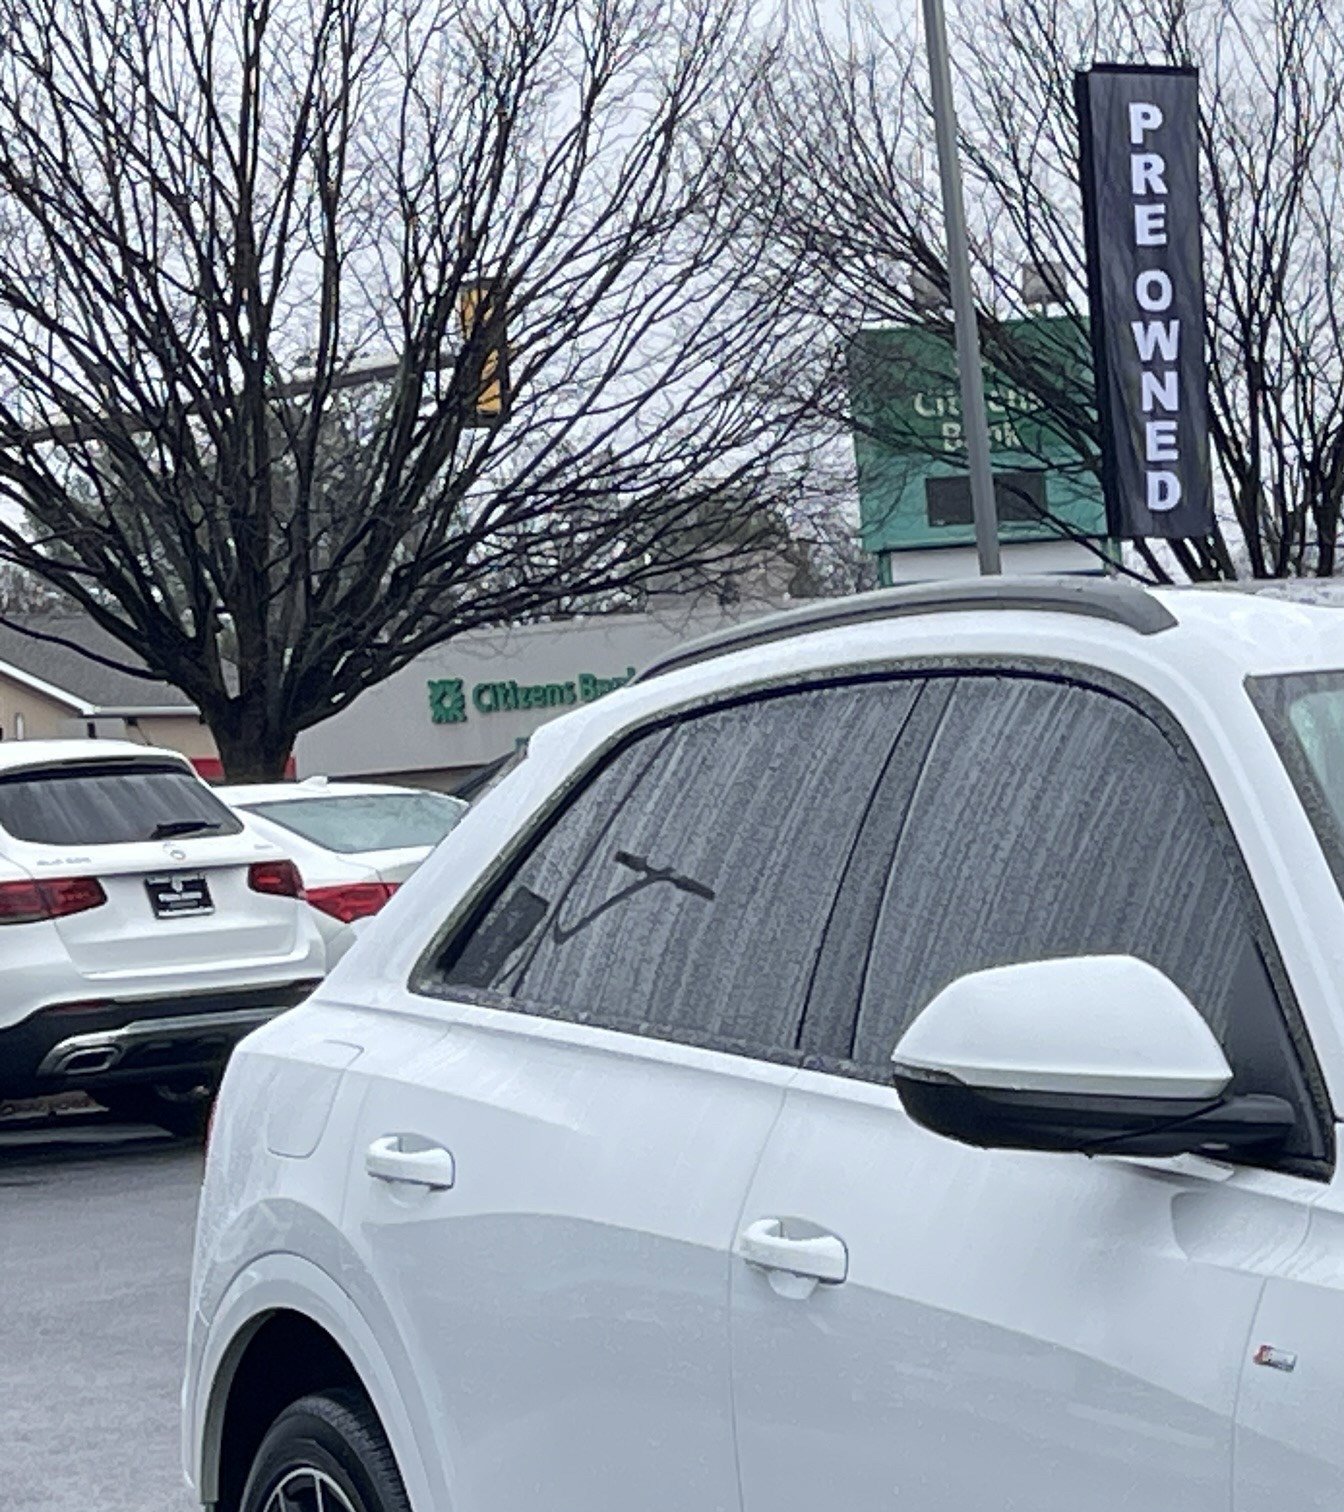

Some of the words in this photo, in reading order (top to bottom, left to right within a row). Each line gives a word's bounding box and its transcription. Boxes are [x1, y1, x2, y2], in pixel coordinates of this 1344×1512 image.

[1128, 102, 1169, 246] PRE
[913, 387, 1045, 417] Citens
[1131, 268, 1182, 512] OWNED
[941, 421, 1021, 453] Bnk
[472, 679, 577, 713] Citizens
[578, 666, 636, 702] Ban
